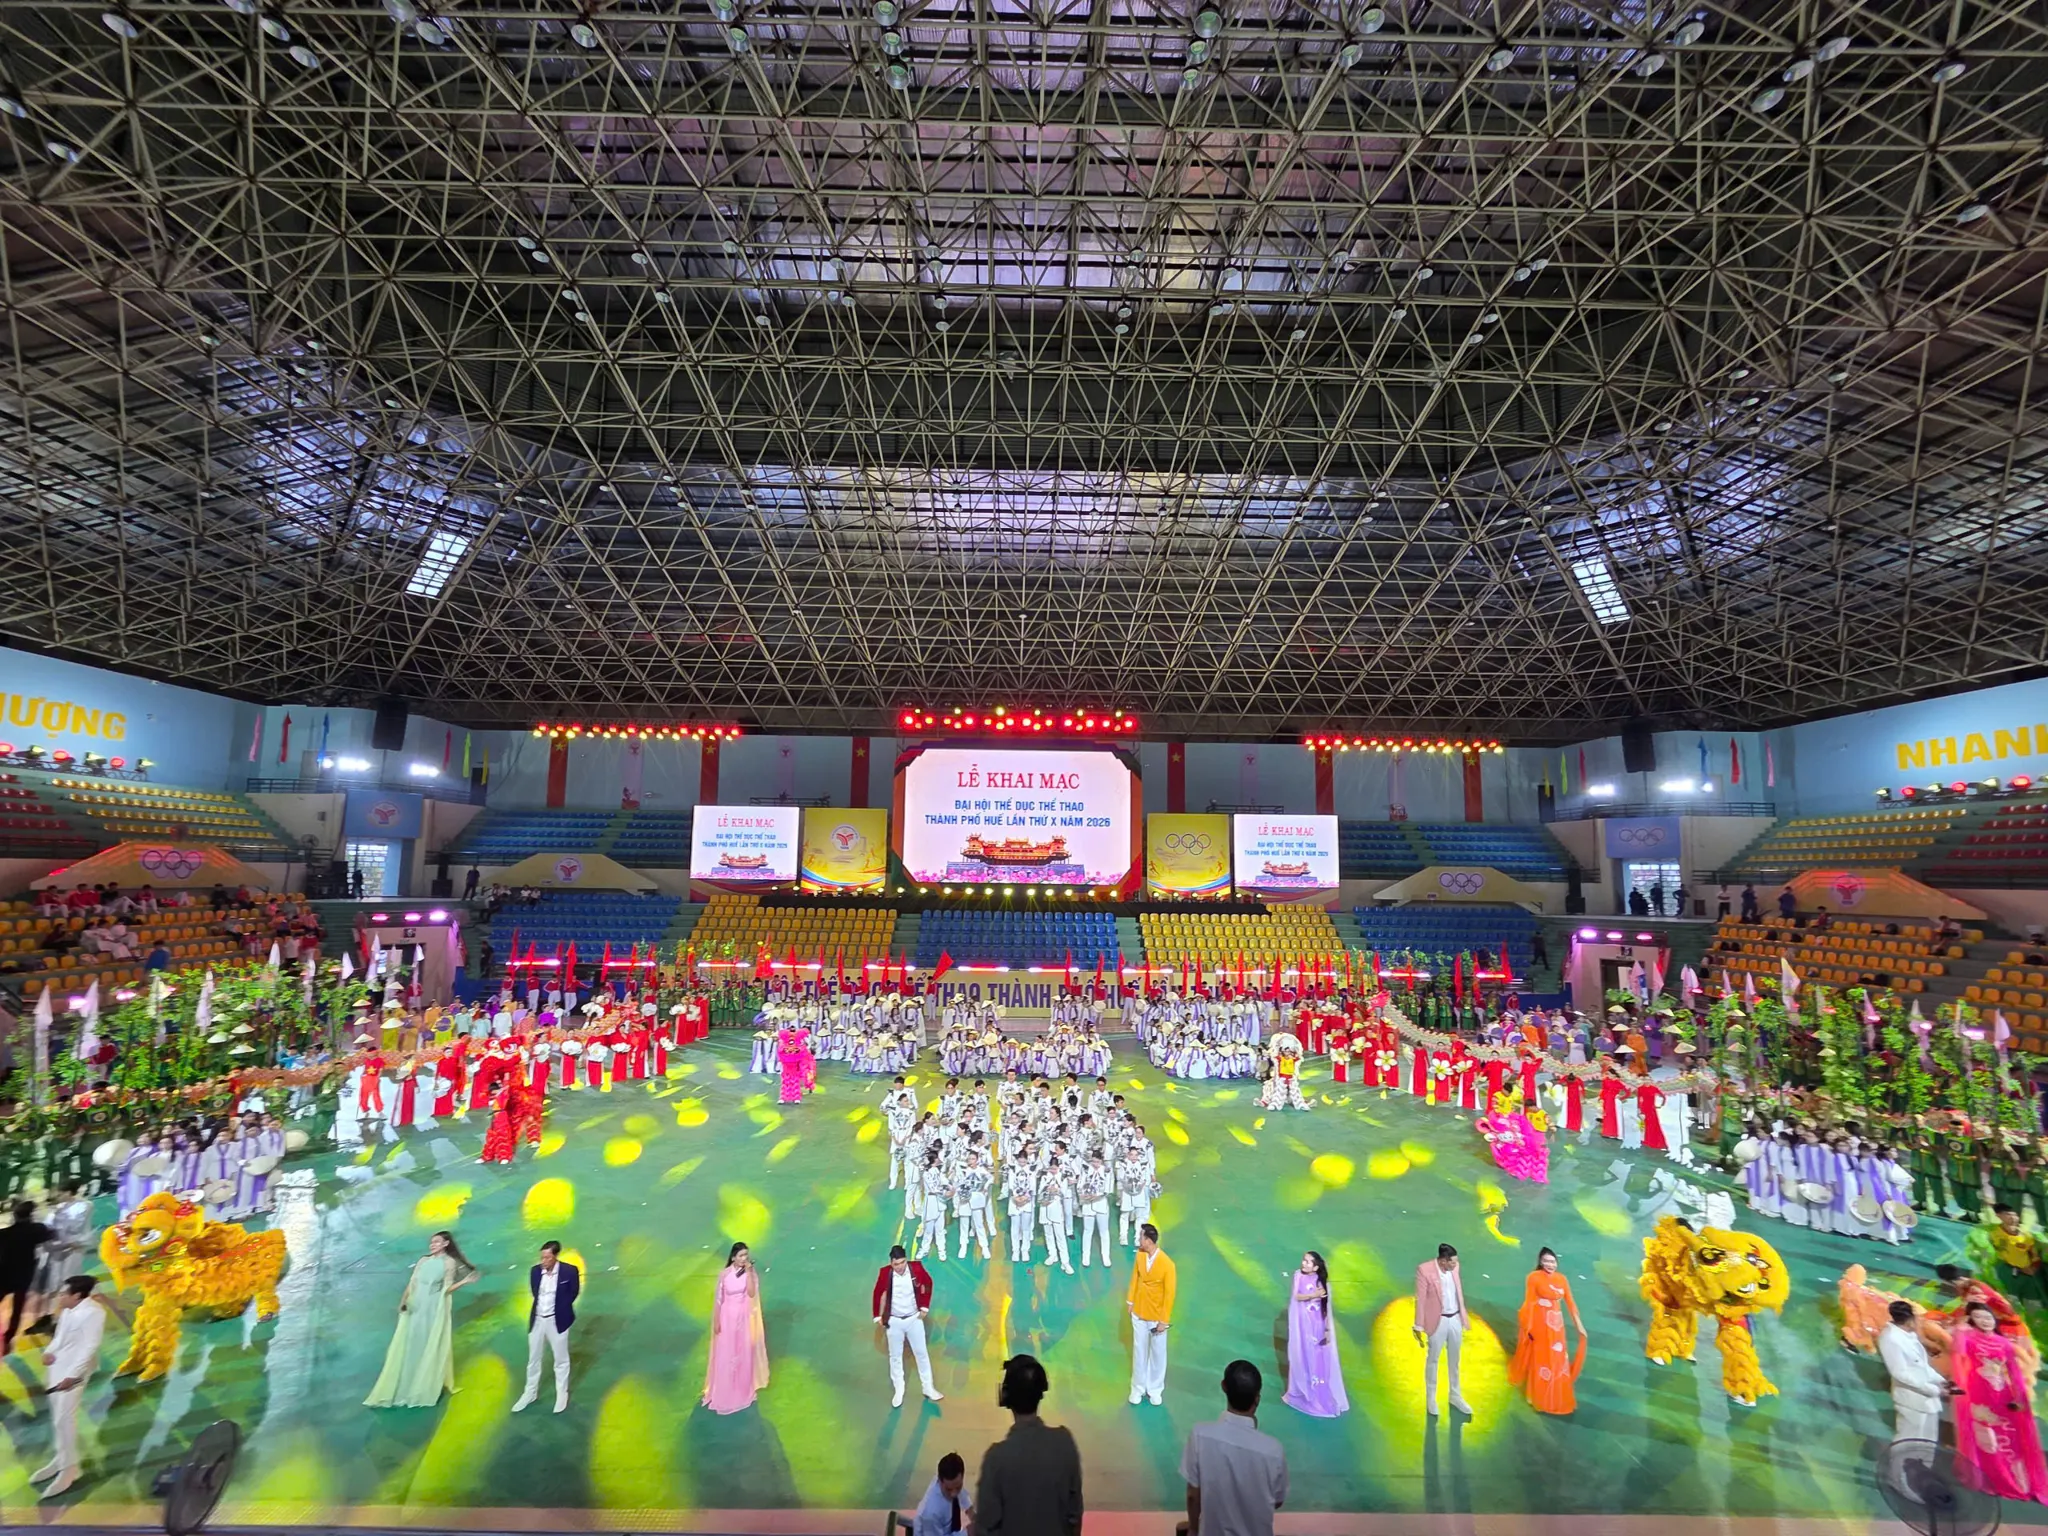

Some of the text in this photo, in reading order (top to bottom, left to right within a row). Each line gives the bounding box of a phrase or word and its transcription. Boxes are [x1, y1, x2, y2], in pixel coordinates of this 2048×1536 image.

[0, 692, 127, 741] ƯỢNG
[957, 764, 1080, 793] LỄ KHAI MẠC
[954, 800, 971, 812] ĐẠI
[974, 800, 991, 813] HỘI
[995, 797, 1013, 811] THỂ
[1015, 801, 1035, 813] DỤC
[1059, 801, 1084, 812] THAO
[731, 818, 753, 828] KHAI
[755, 818, 775, 831] MẠC
[925, 813, 957, 825] THÀNH
[961, 812, 981, 825] PHỐ
[983, 812, 1004, 826] HUẾ
[1028, 814, 1048, 827] THỨ
[1050, 816, 1057, 827] X
[1060, 814, 1083, 827] NĂM
[1086, 817, 1111, 828] 2026
[1271, 826, 1293, 836] KHAI
[987, 978, 1052, 1008] THÀNH
